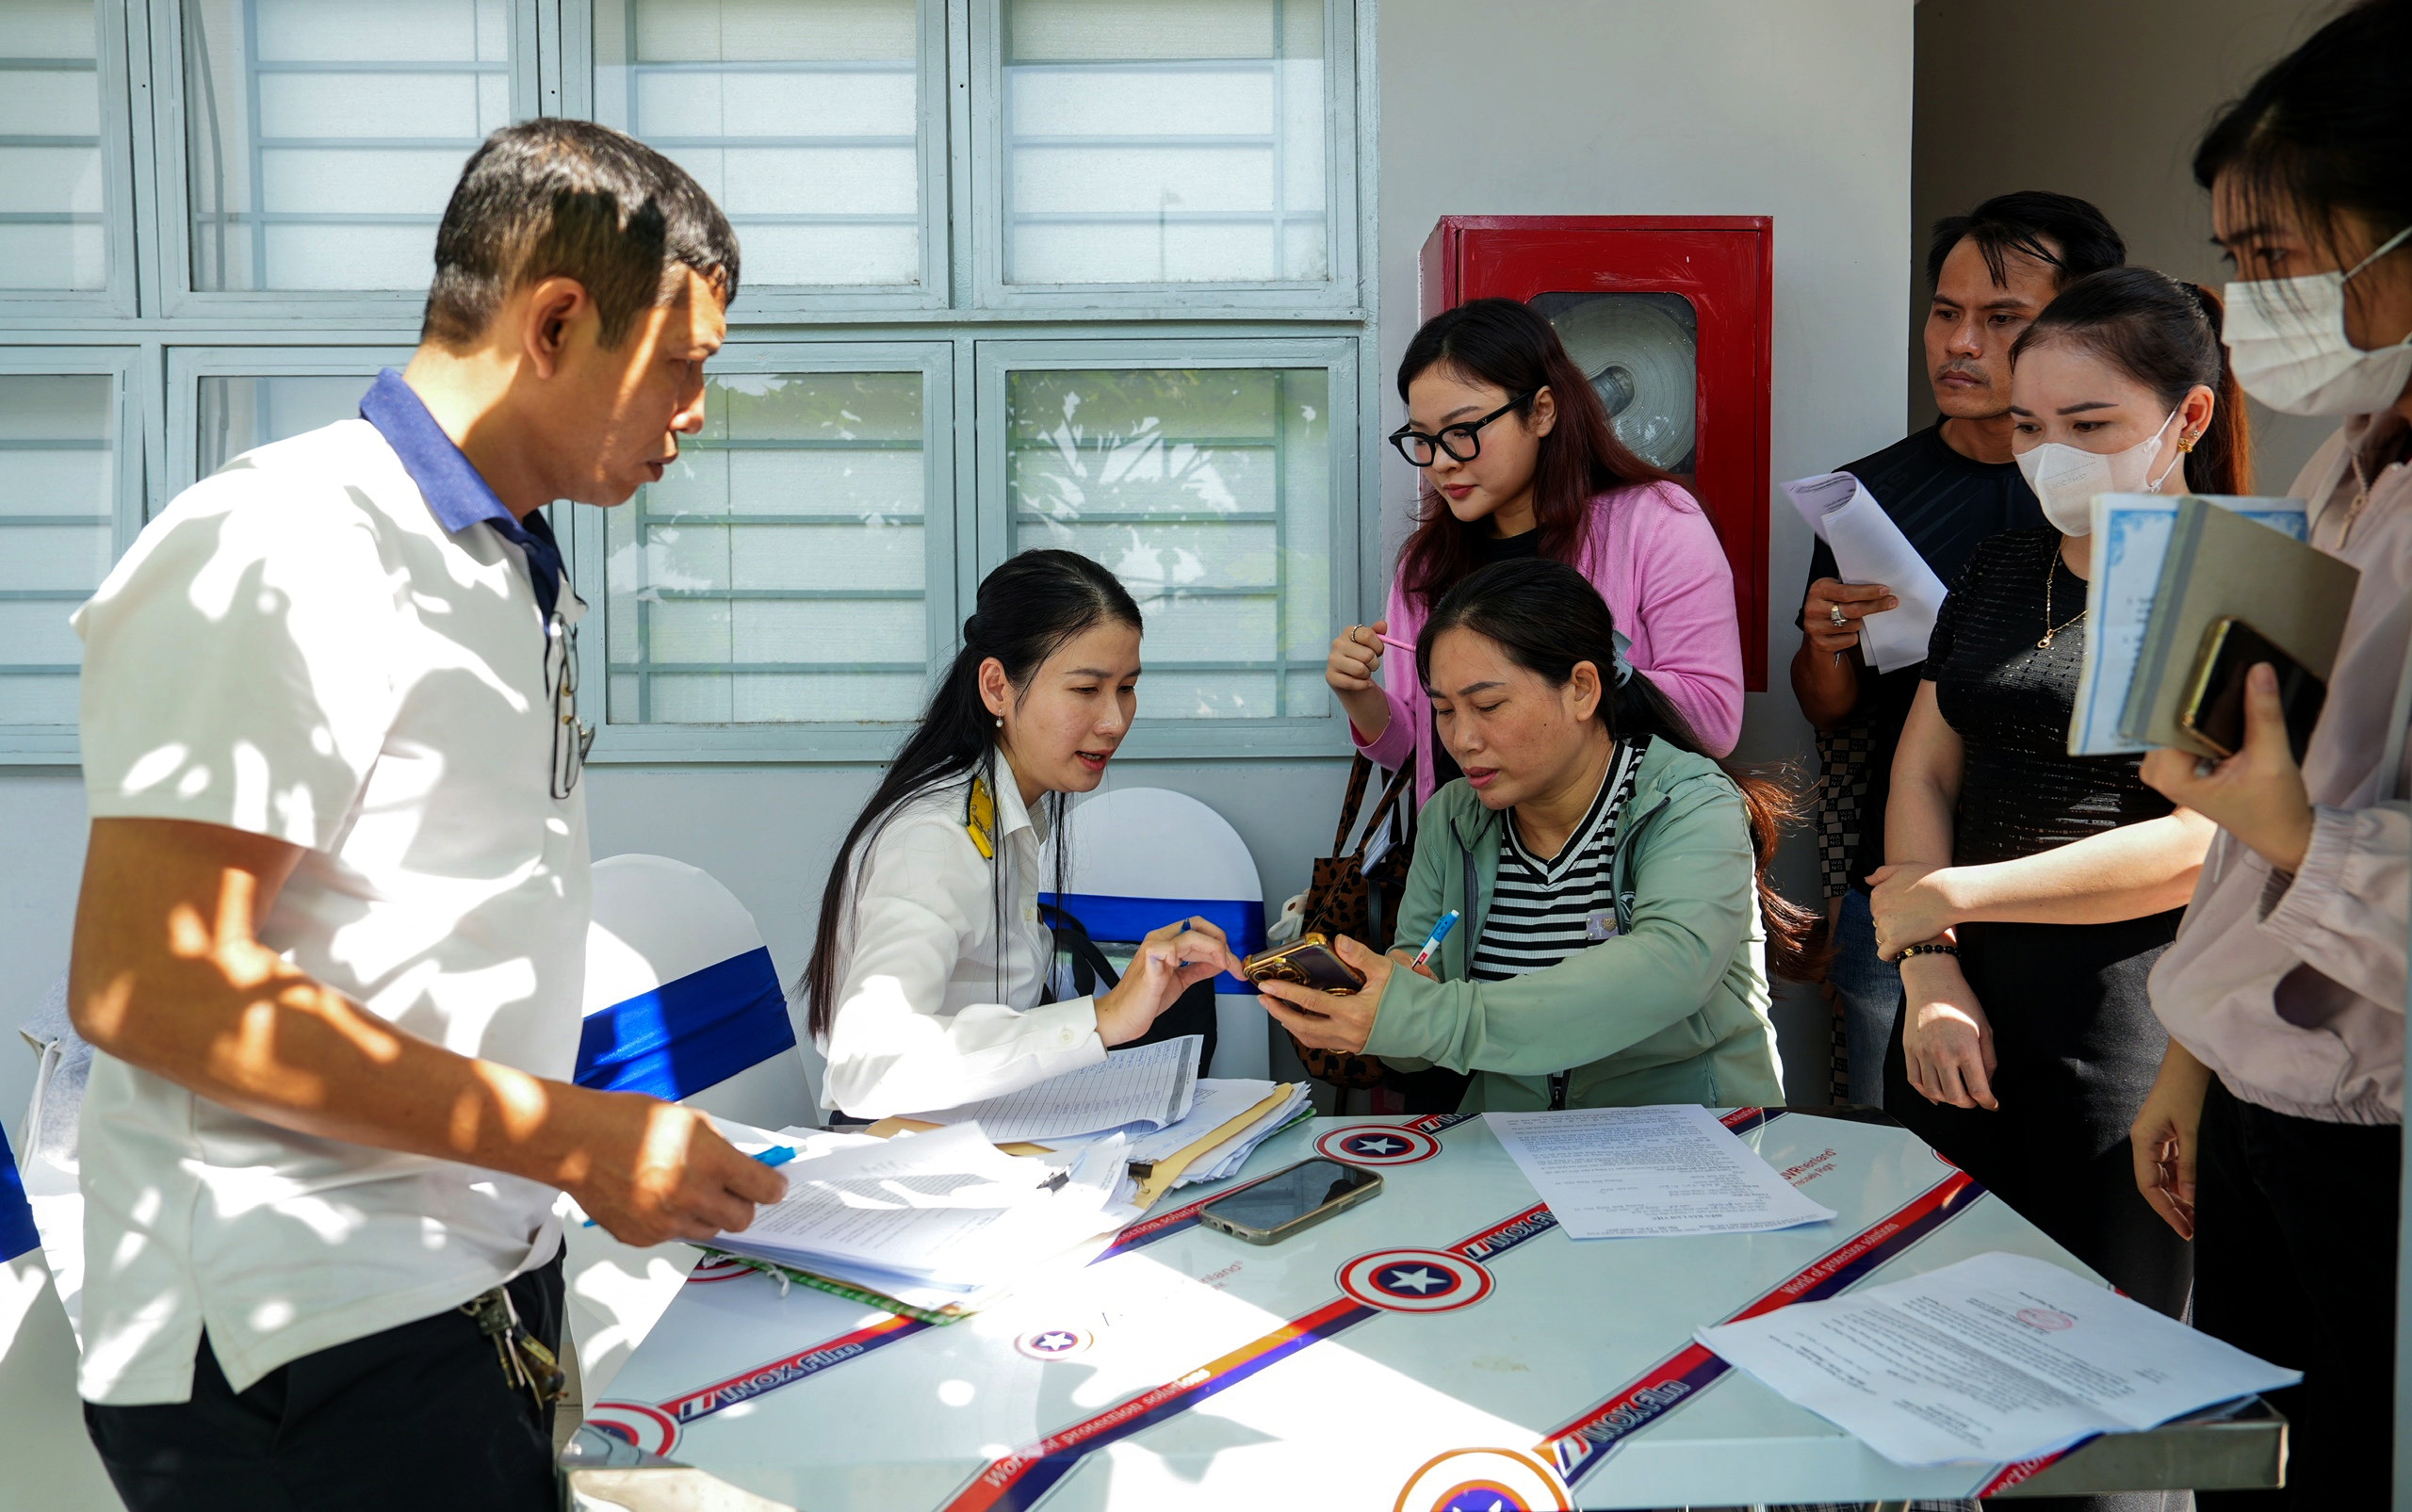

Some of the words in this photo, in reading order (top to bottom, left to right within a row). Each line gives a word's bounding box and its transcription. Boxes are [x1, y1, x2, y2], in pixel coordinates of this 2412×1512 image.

[1779, 1274, 1817, 1295] World
[1811, 1267, 1827, 1278] of
[1821, 1243, 1867, 1273] protection
[1861, 1223, 1900, 1246] solutions
[982, 1441, 1045, 1489] Wor
[1061, 1401, 1144, 1447] protection
[1141, 1368, 1212, 1407] solutions
